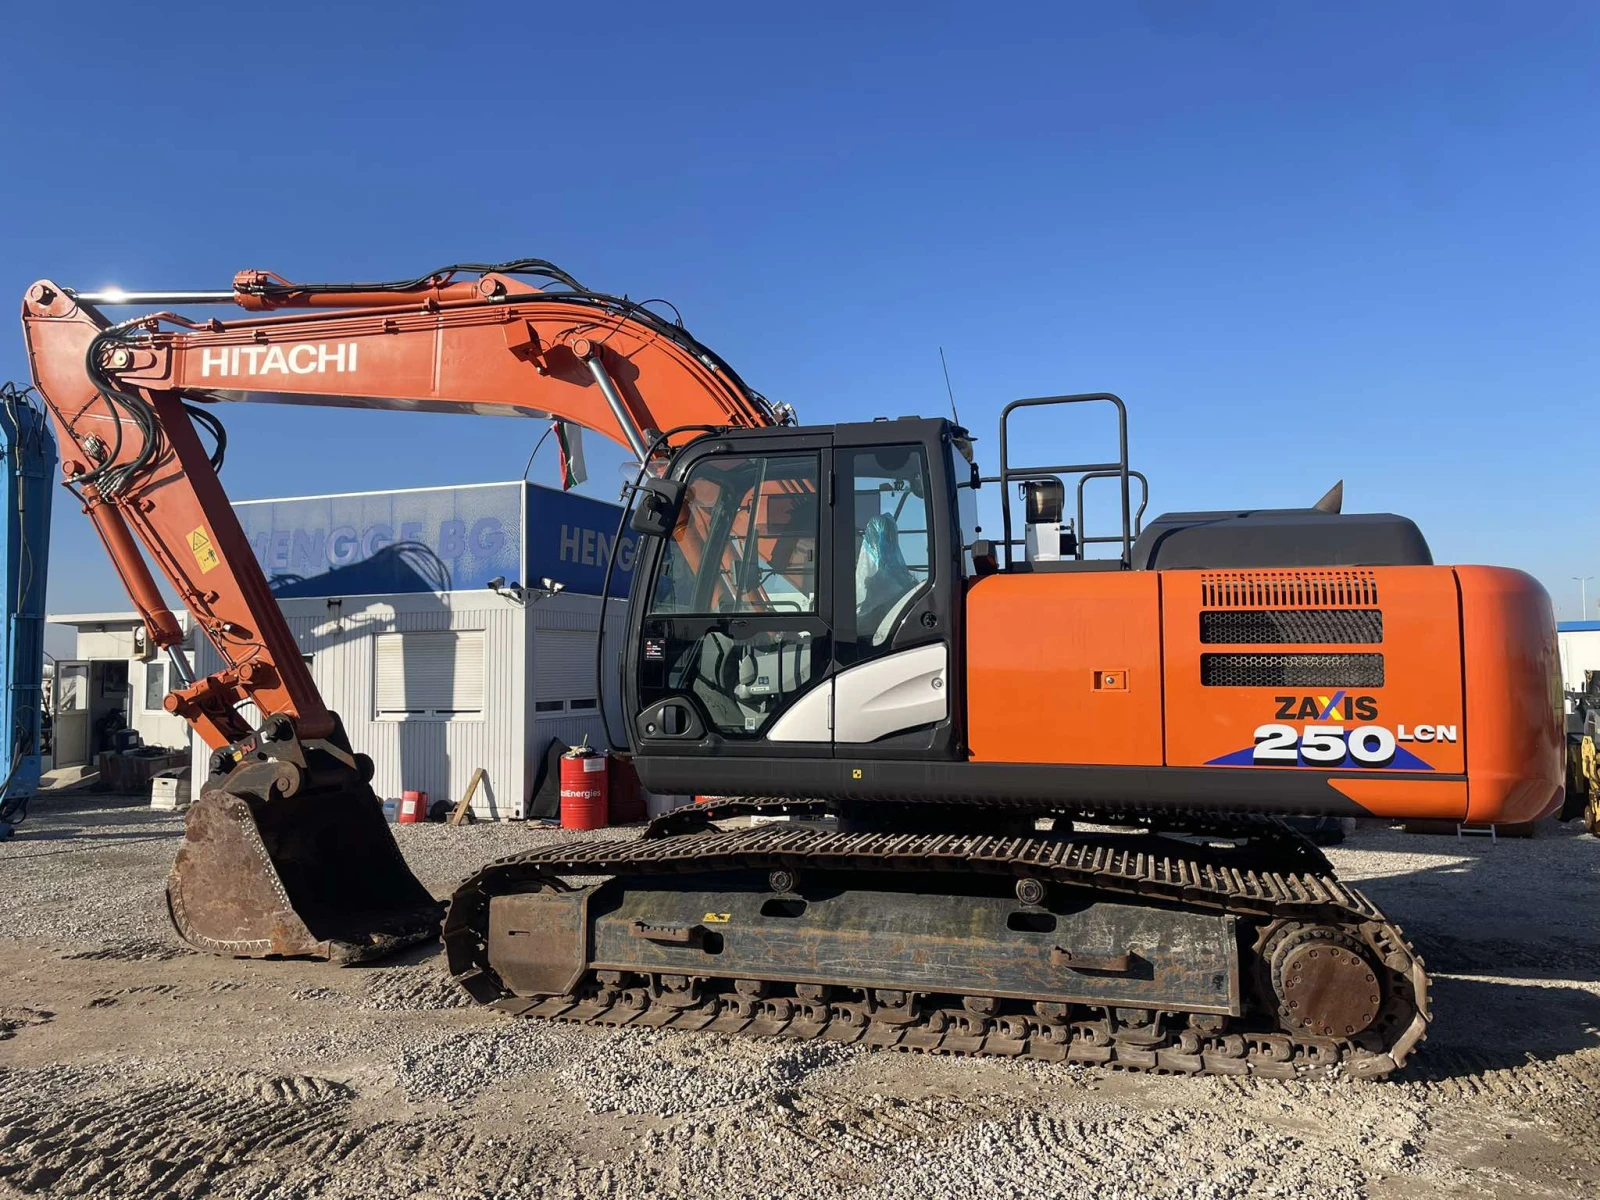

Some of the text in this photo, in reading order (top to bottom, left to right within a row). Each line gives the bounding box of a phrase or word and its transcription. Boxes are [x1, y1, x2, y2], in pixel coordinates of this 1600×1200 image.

[202, 343, 357, 377] HITACHI
[438, 517, 505, 561] BG
[1274, 690, 1378, 721] ZAXIS
[1252, 723, 1457, 769] 250 LCN
